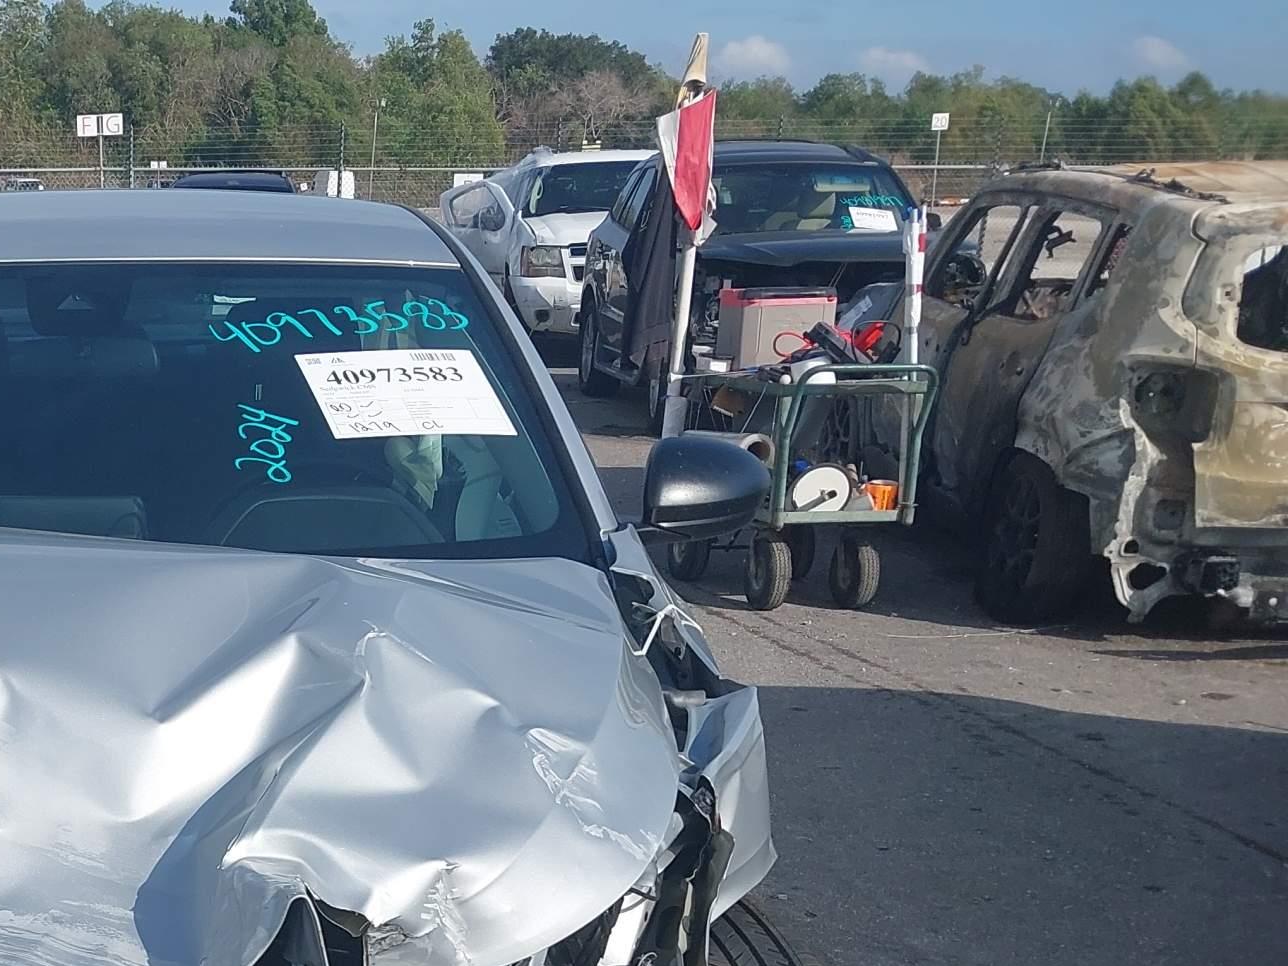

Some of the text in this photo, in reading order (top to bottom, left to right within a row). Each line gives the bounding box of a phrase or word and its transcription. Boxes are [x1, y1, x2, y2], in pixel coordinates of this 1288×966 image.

[81, 116, 92, 134] F
[105, 115, 120, 134] G
[933, 115, 948, 128] 20
[208, 299, 469, 353] 40973583
[325, 366, 464, 385] 40973583
[235, 404, 300, 484] 2024
